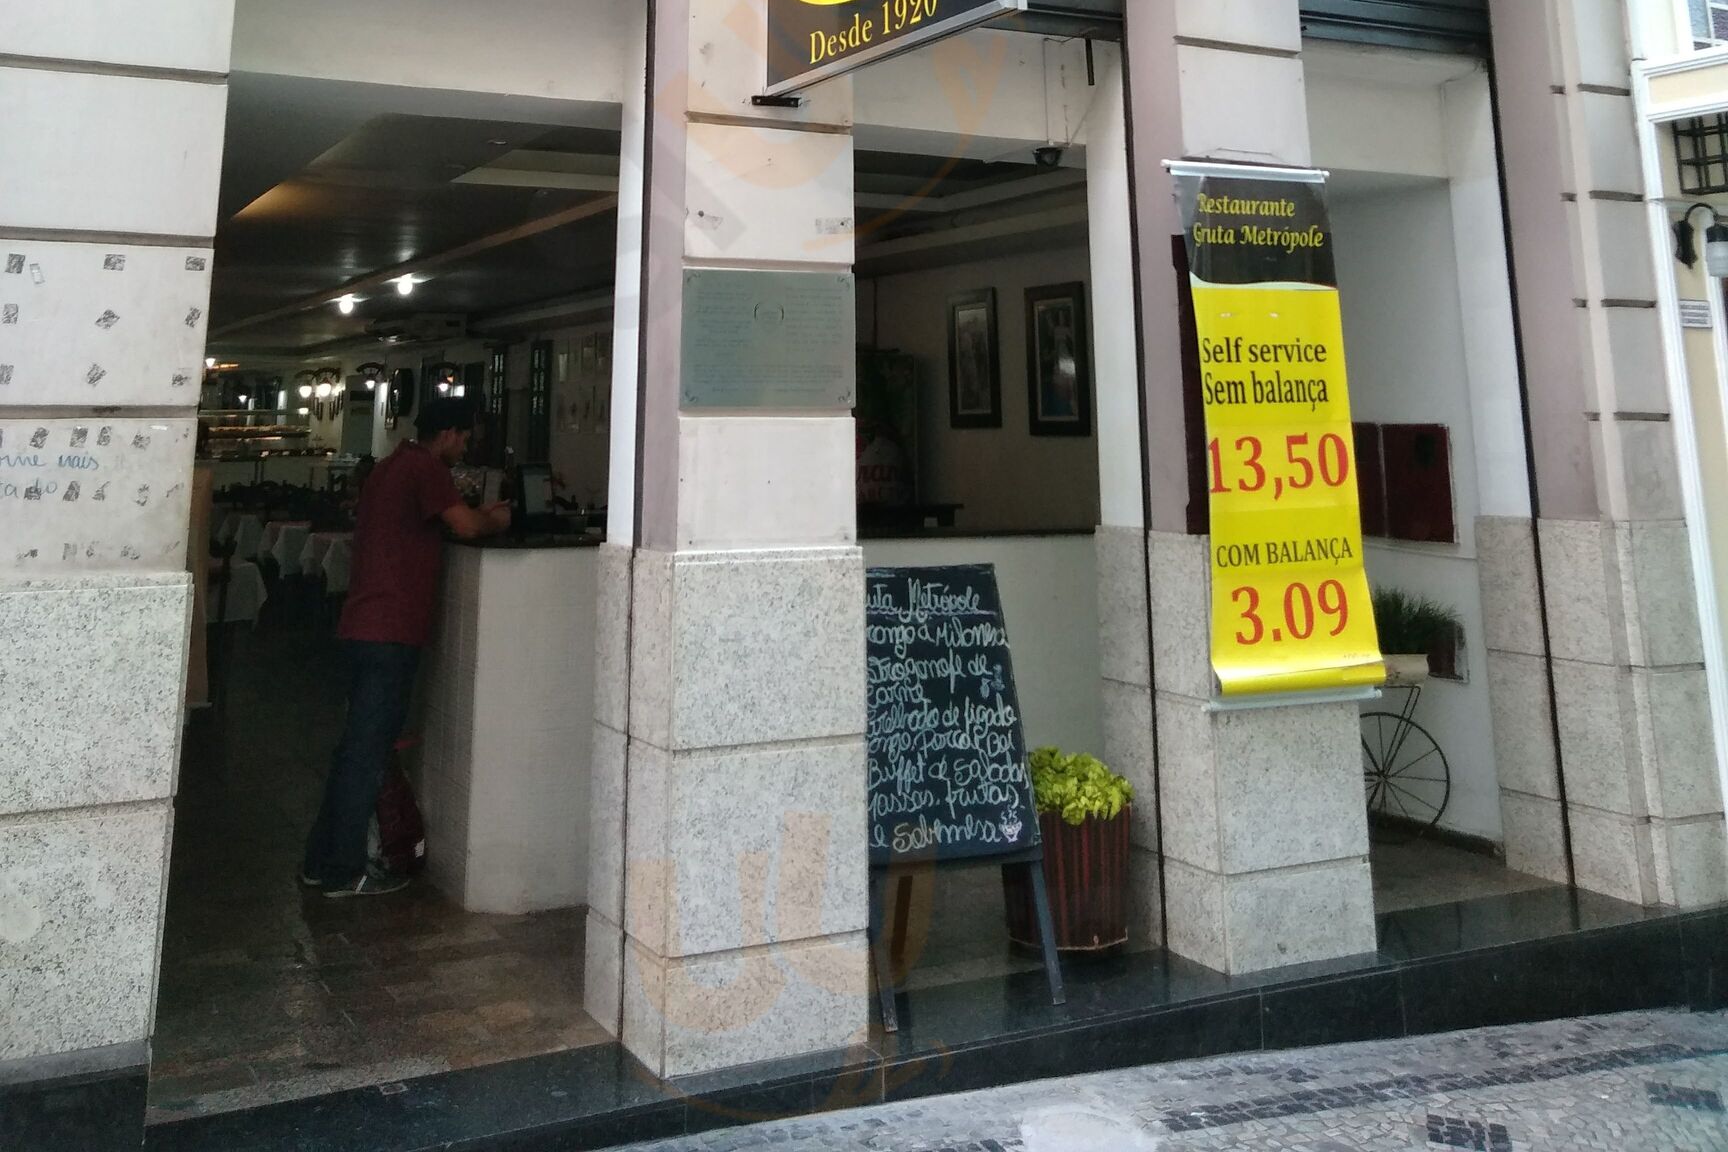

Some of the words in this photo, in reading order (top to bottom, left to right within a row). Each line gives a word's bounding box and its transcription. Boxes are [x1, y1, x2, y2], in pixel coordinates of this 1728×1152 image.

[808, 9, 873, 65] Desde
[1196, 193, 1296, 217] Restaurante
[1193, 222, 1236, 247] Gruta
[1239, 224, 1324, 254] Metrópole
[1203, 336, 1243, 363] Self
[1248, 337, 1327, 363] service
[1204, 371, 1248, 405] Sem
[1250, 369, 1329, 412] balança
[1208, 432, 1349, 501] 13,50
[1216, 542, 1261, 568] COM
[1265, 536, 1353, 566] BALANÇA
[1231, 579, 1349, 645] 3.09
